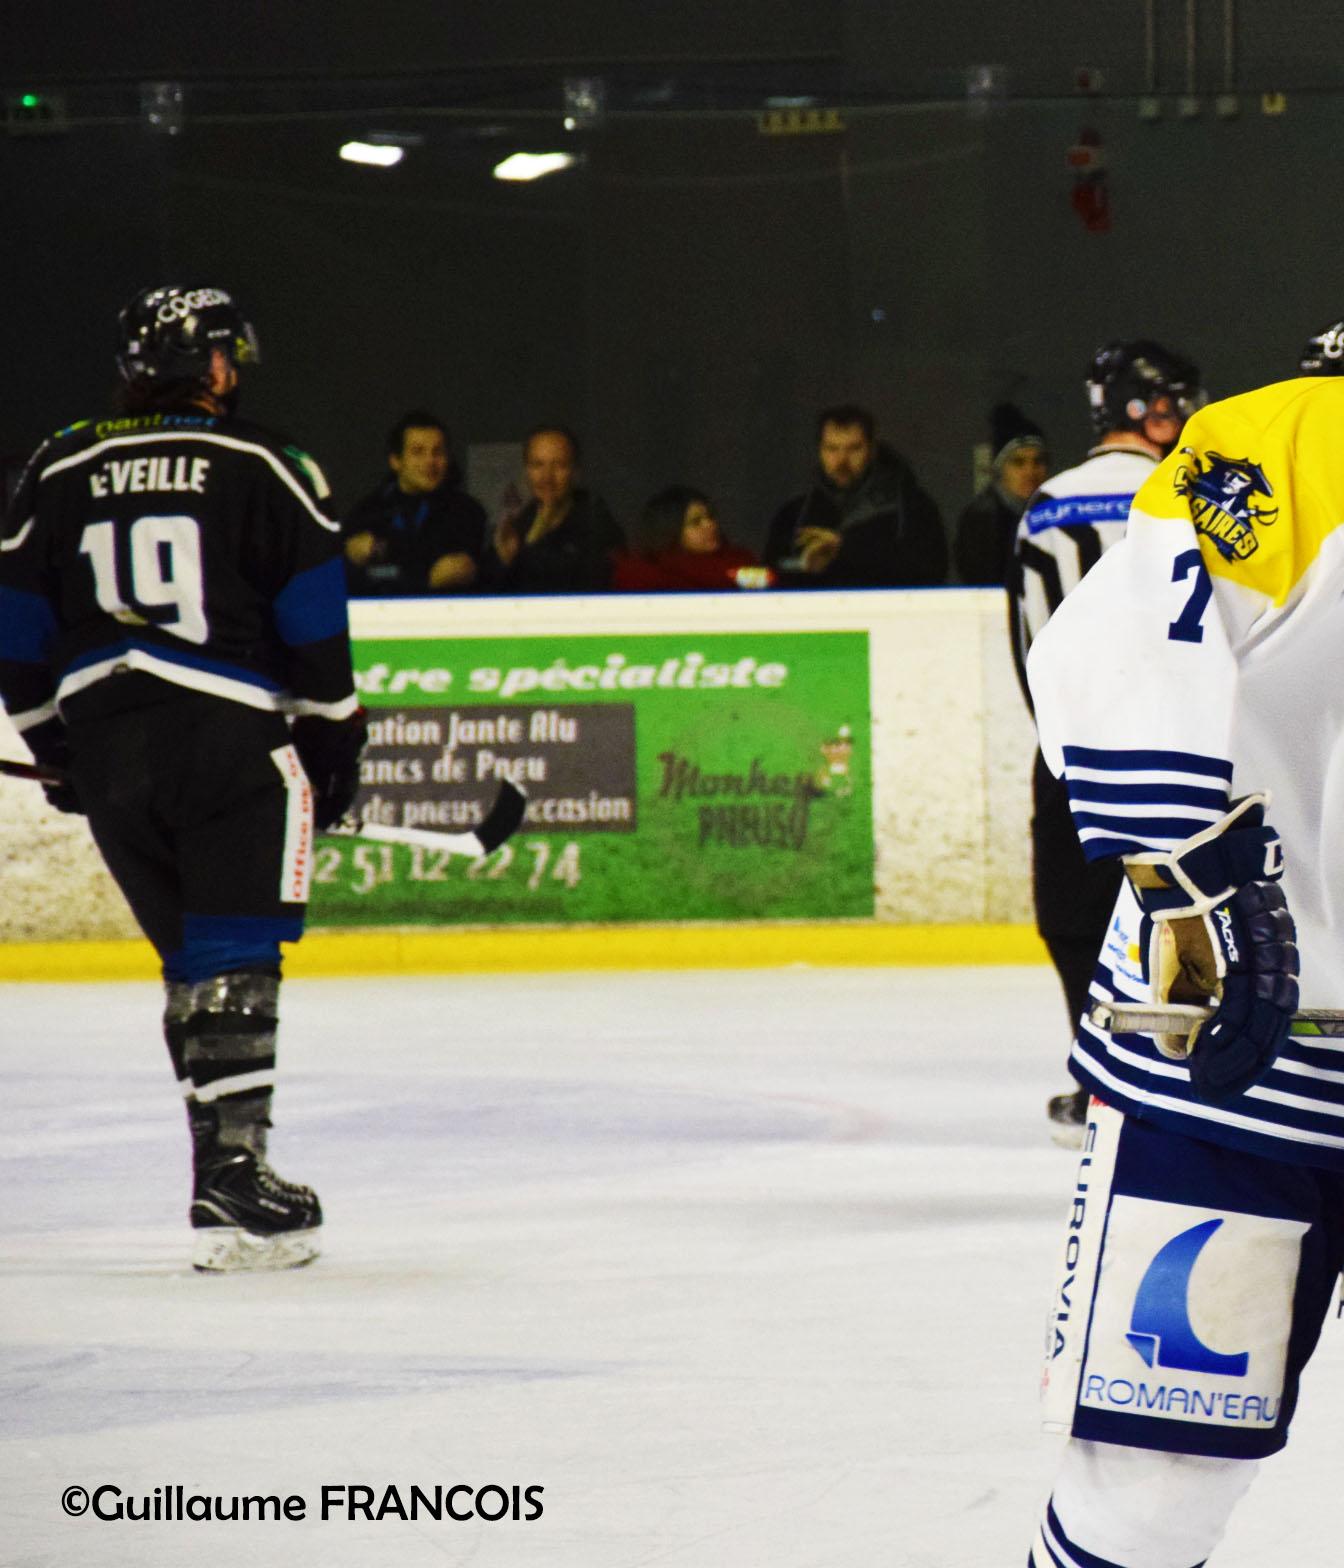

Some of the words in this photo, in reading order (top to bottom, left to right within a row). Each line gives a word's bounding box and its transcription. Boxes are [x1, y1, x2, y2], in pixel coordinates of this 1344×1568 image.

[79, 515, 209, 646] 19
[1167, 547, 1214, 644] 7
[468, 651, 788, 699] spécialiste
[366, 713, 441, 746] ation
[446, 711, 523, 751] Jante
[529, 709, 578, 743] Alu
[359, 758, 424, 784] ancs
[431, 750, 466, 783] de
[475, 749, 547, 783] Pneu
[361, 794, 395, 824] de
[403, 799, 483, 827] pneus
[313, 845, 343, 884] 2
[351, 845, 394, 895] 51
[409, 844, 450, 882] 12
[466, 842, 514, 881] 22
[523, 841, 583, 891] 74
[1214, 907, 1240, 964] TACKS
[1083, 1373, 1279, 1423] ROMAN'EAU
